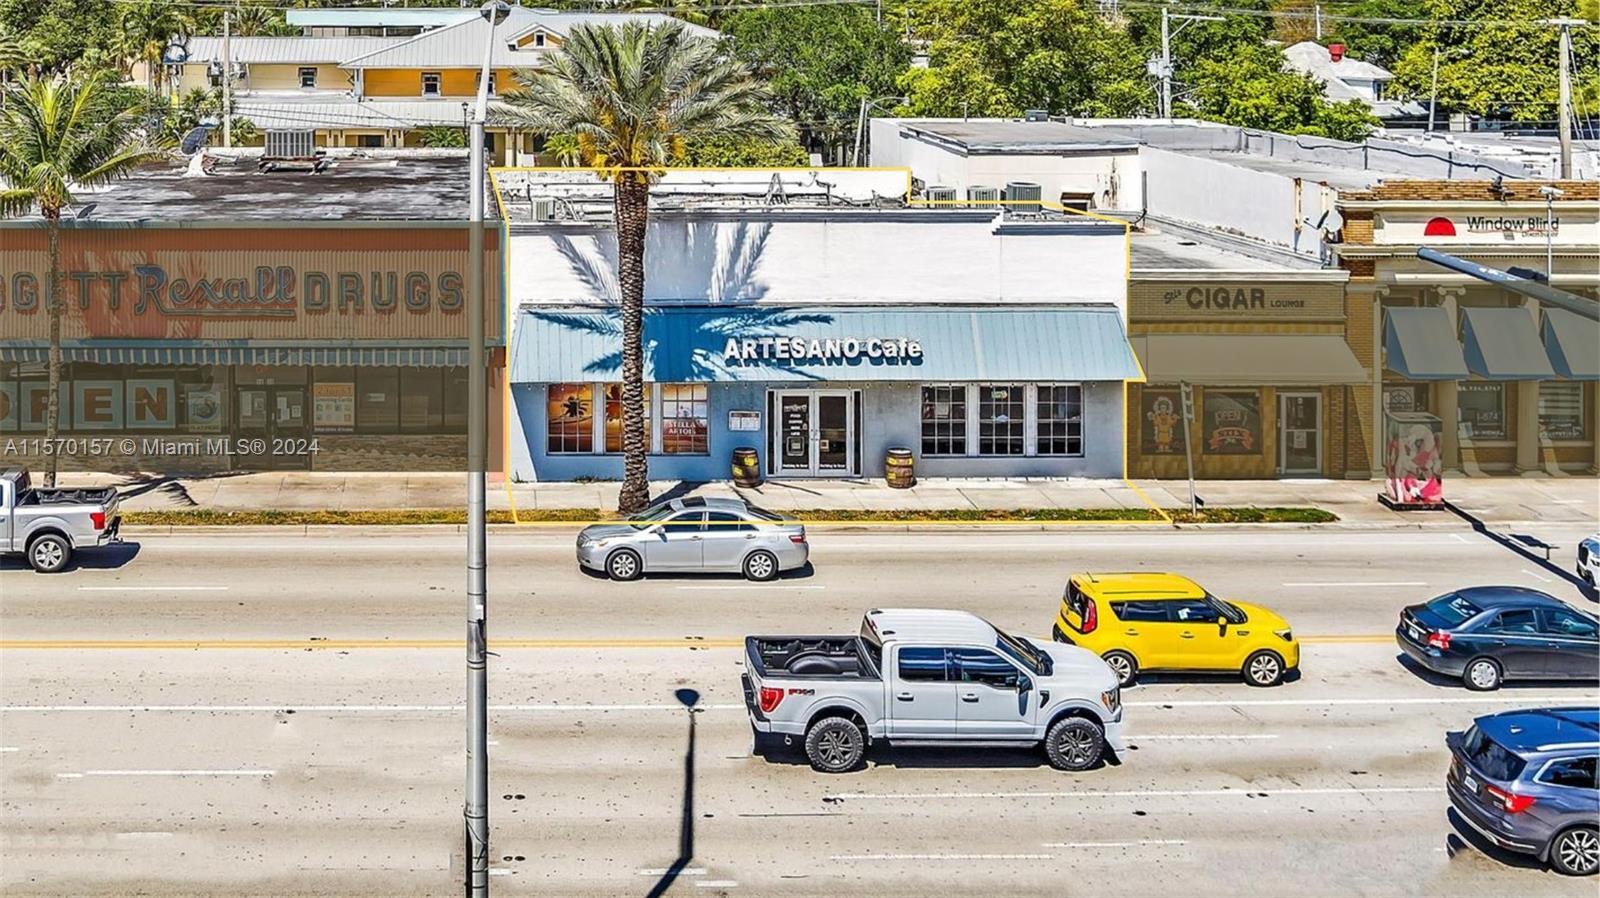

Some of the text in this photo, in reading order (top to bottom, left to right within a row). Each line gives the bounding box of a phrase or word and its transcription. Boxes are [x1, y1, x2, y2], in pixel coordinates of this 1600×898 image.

[1466, 216, 1559, 231] Window Blind
[0, 264, 464, 317] GETT Rexall DRUGS
[1185, 286, 1265, 310] CIGAR
[724, 337, 923, 360] ARTESANO Cafe
